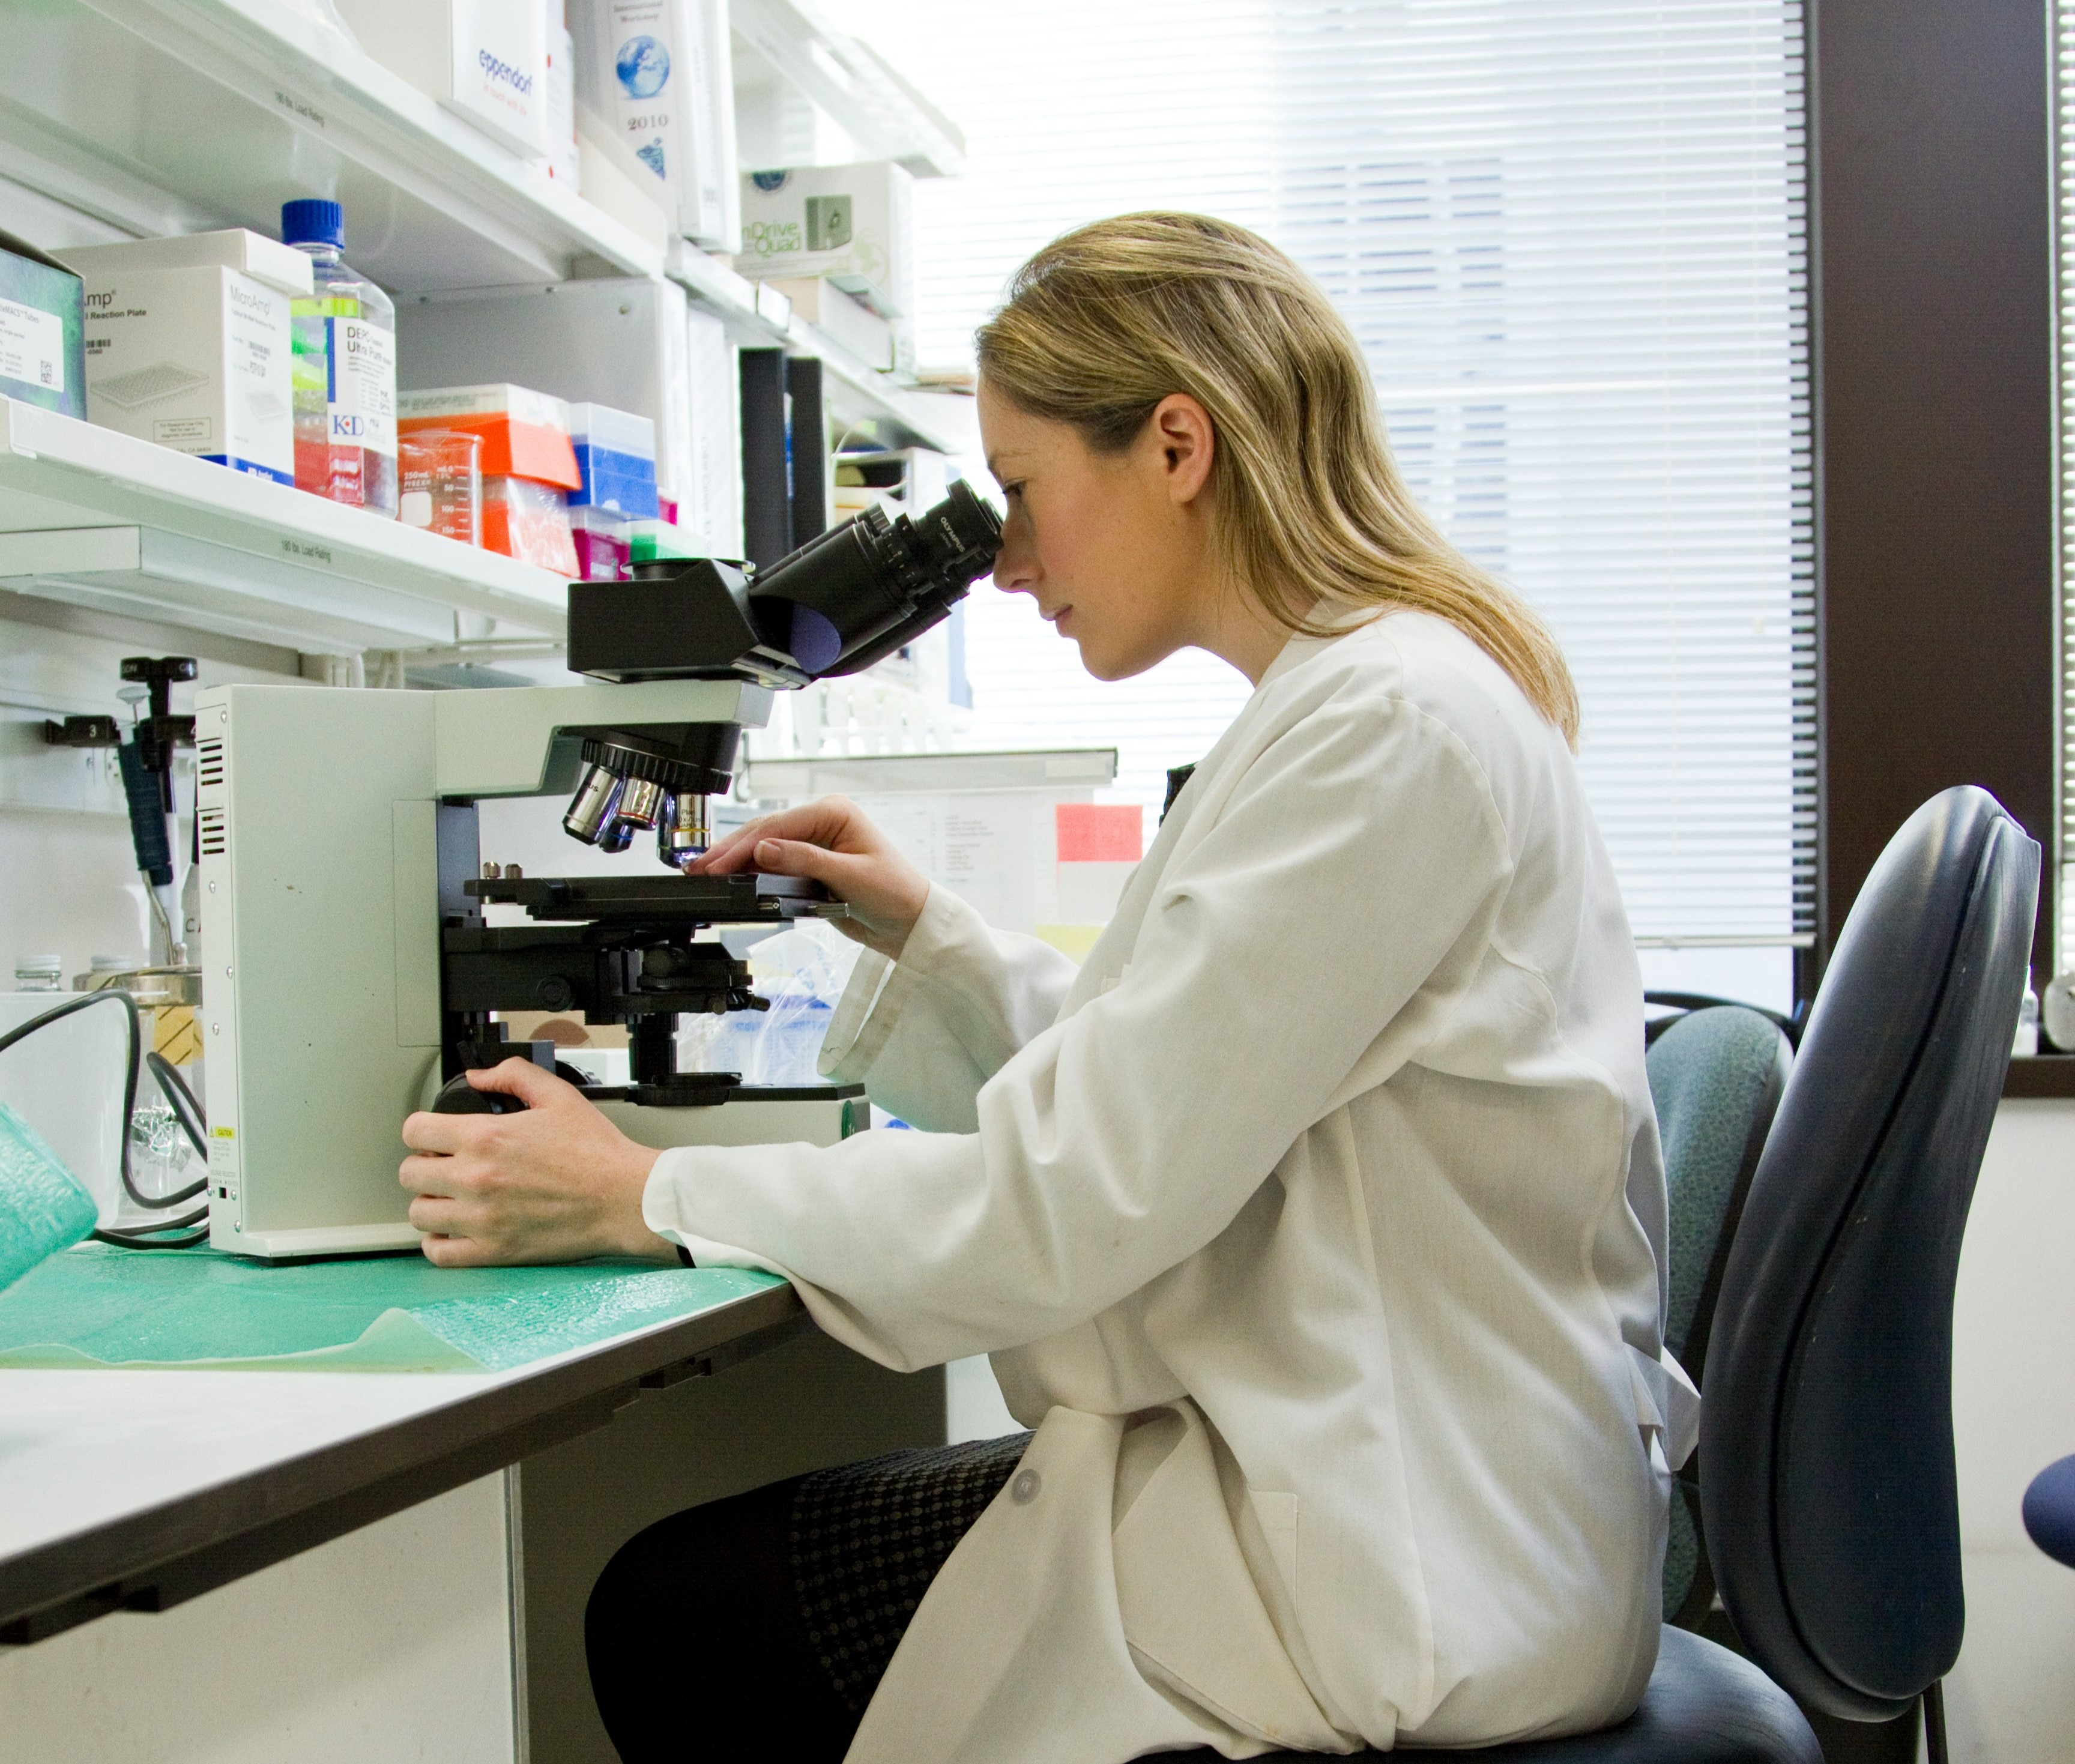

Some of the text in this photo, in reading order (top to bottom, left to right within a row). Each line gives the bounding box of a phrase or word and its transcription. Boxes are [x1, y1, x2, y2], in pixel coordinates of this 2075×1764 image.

[479, 49, 533, 97] eppendorf
[628, 113, 669, 131] 2010
[754, 235, 801, 258] Quad
[90, 312, 125, 320] Reaction
[126, 309, 147, 317] Plate
[347, 326, 370, 343] DEPC
[347, 340, 367, 356] Ultra
[369, 346, 382, 362] Pure
[441, 505, 455, 513] 100
[442, 526, 456, 534] 150
[940, 516, 965, 553] OLYMPUS
[89, 724, 97, 737] 3
